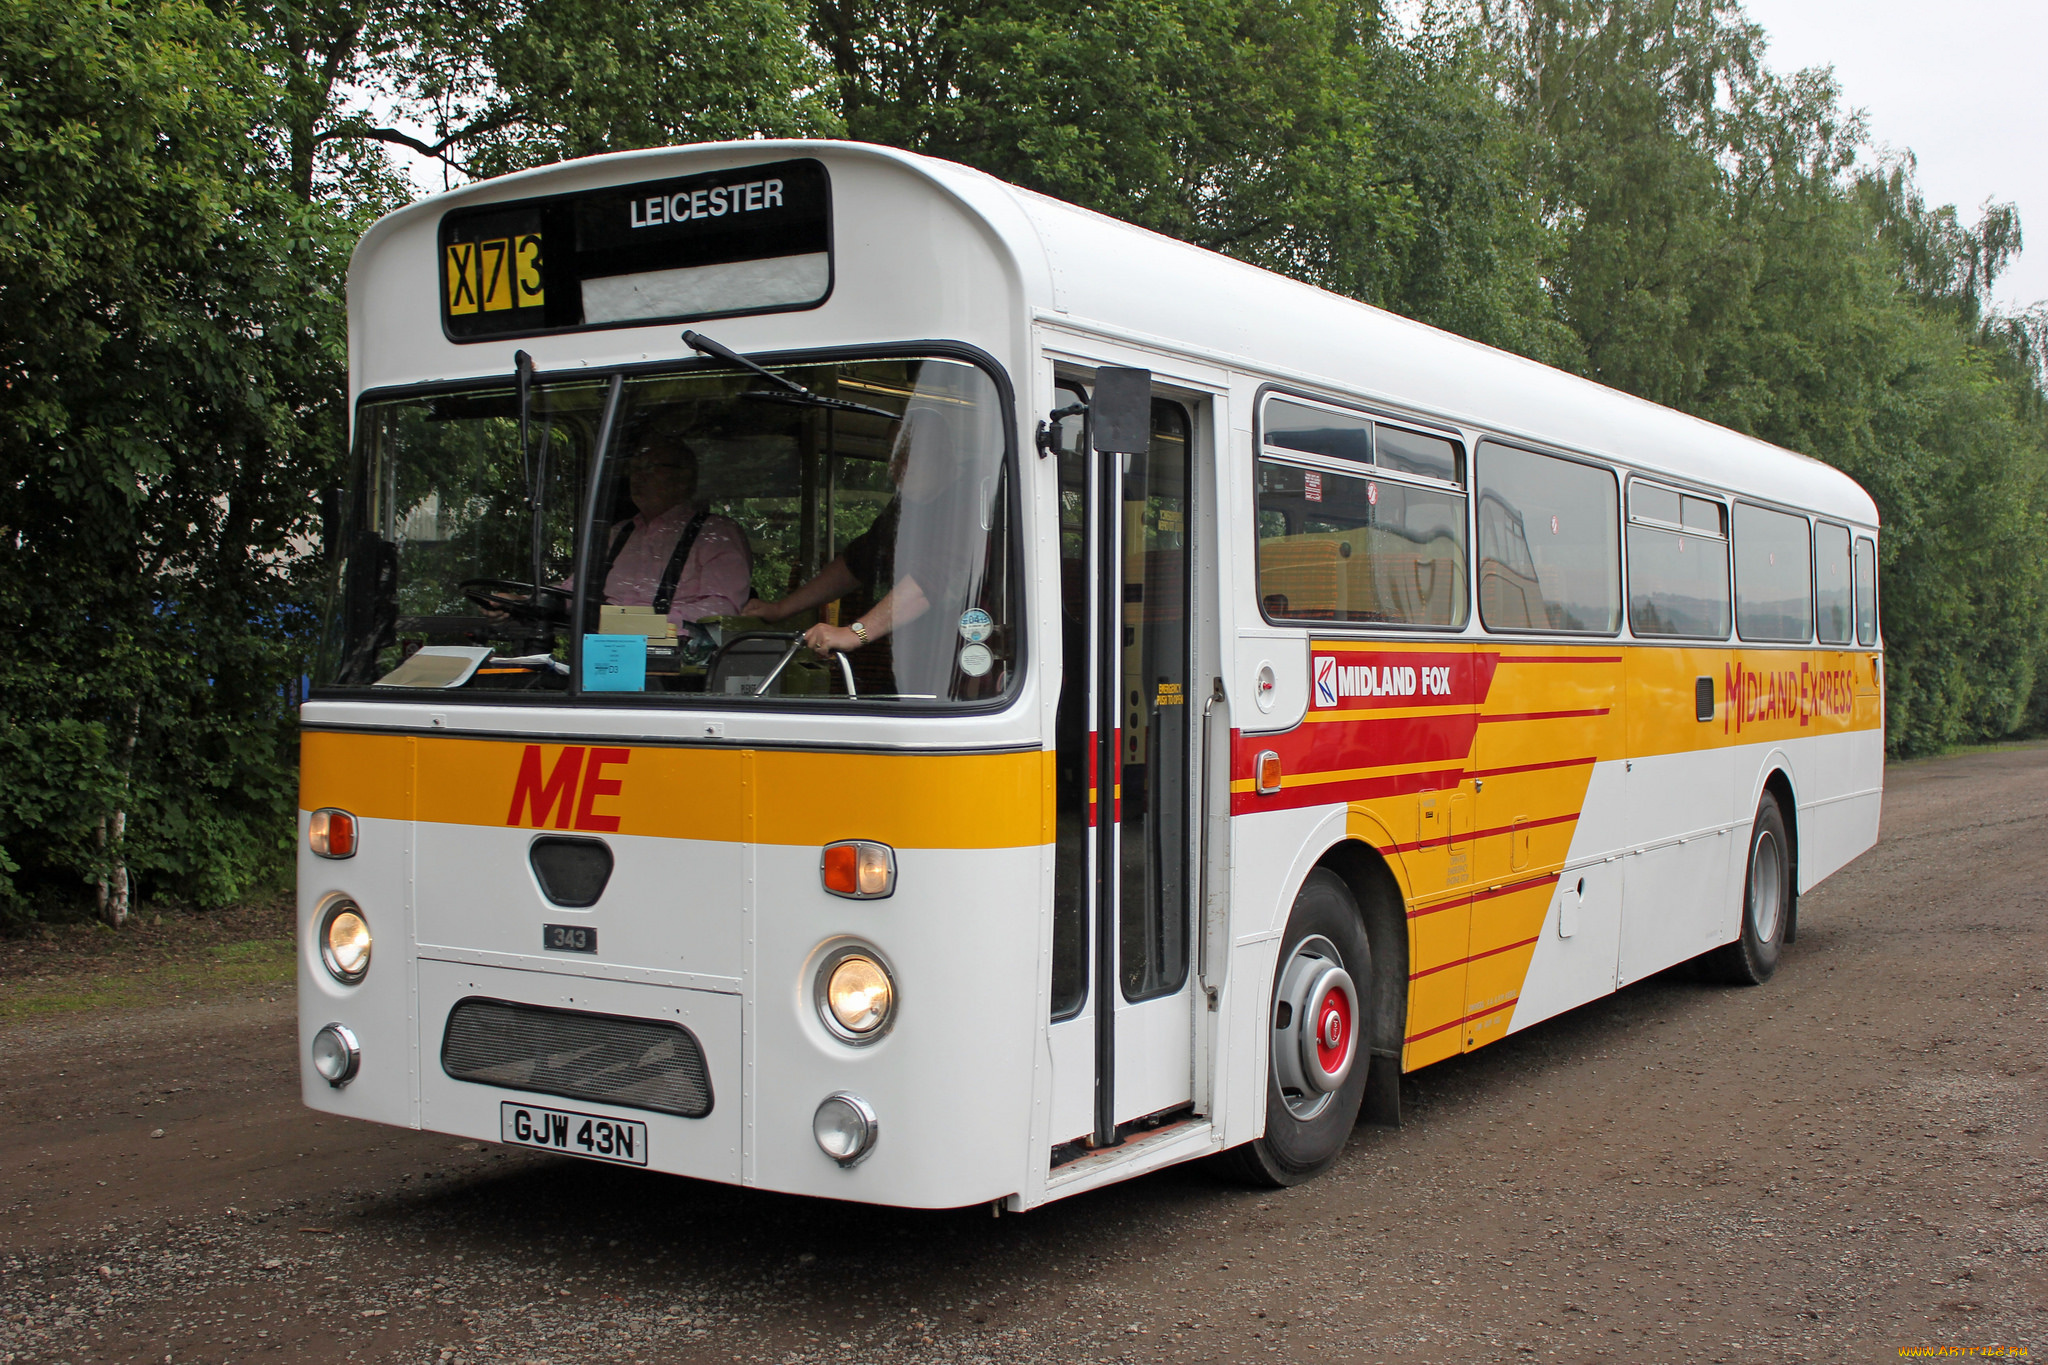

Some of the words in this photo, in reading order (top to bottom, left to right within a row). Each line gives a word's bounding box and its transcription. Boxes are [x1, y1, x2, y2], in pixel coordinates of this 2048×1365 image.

[631, 178, 783, 228] LEICESTER
[450, 234, 543, 306] X73
[1337, 666, 1416, 696] MIDLAND
[1421, 667, 1451, 695] FOX
[1725, 662, 1798, 735] MIDLAND
[1800, 661, 1852, 726] EXPRESS
[506, 744, 631, 833] ME
[554, 928, 586, 948] 343
[514, 1109, 568, 1147] GJW
[577, 1119, 634, 1158] 43N
